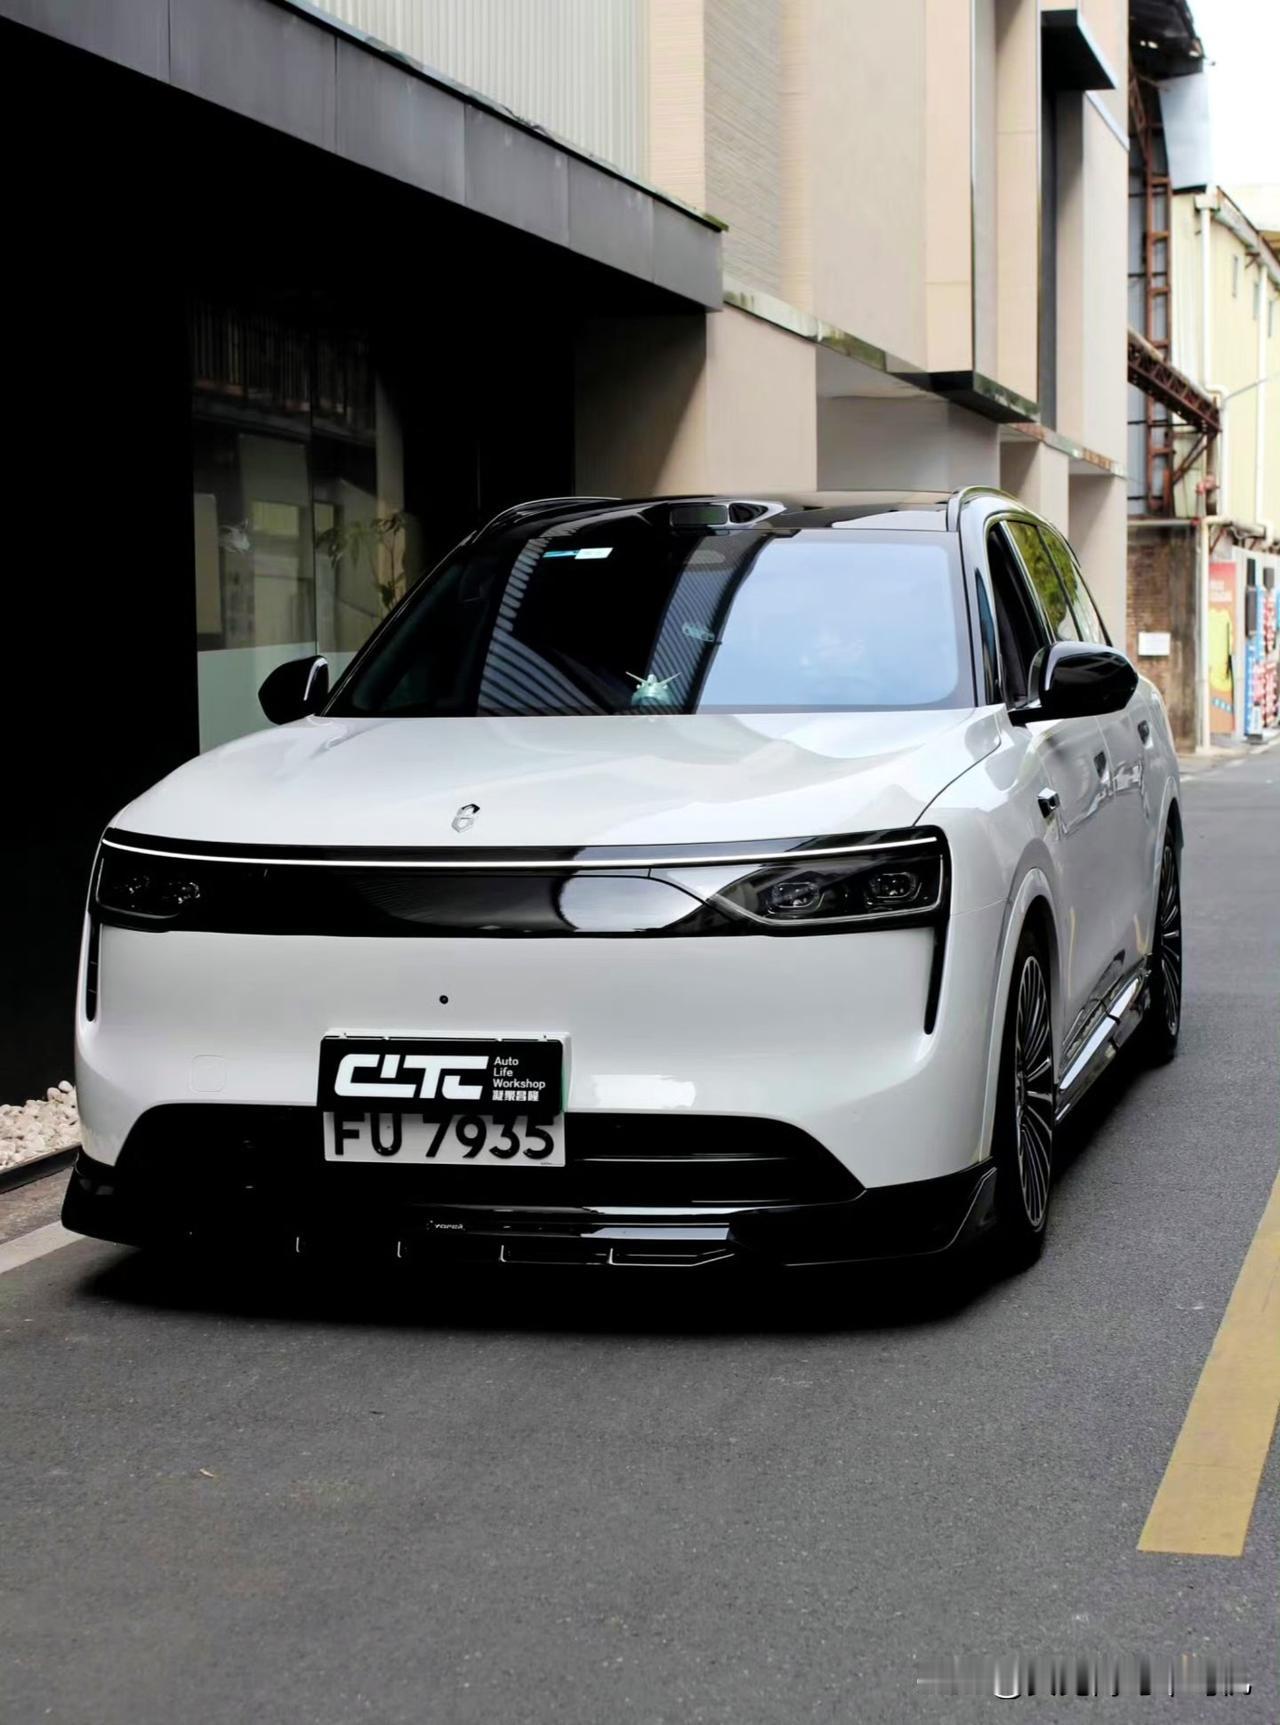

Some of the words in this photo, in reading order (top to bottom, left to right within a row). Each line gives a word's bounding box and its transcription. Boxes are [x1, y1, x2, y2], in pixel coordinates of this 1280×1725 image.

[494, 1056, 519, 1066] Auto
[493, 1067, 513, 1077] Life
[493, 1078, 546, 1090] Workshop
[333, 1112, 402, 1157] FU
[423, 1114, 554, 1160] 7935
